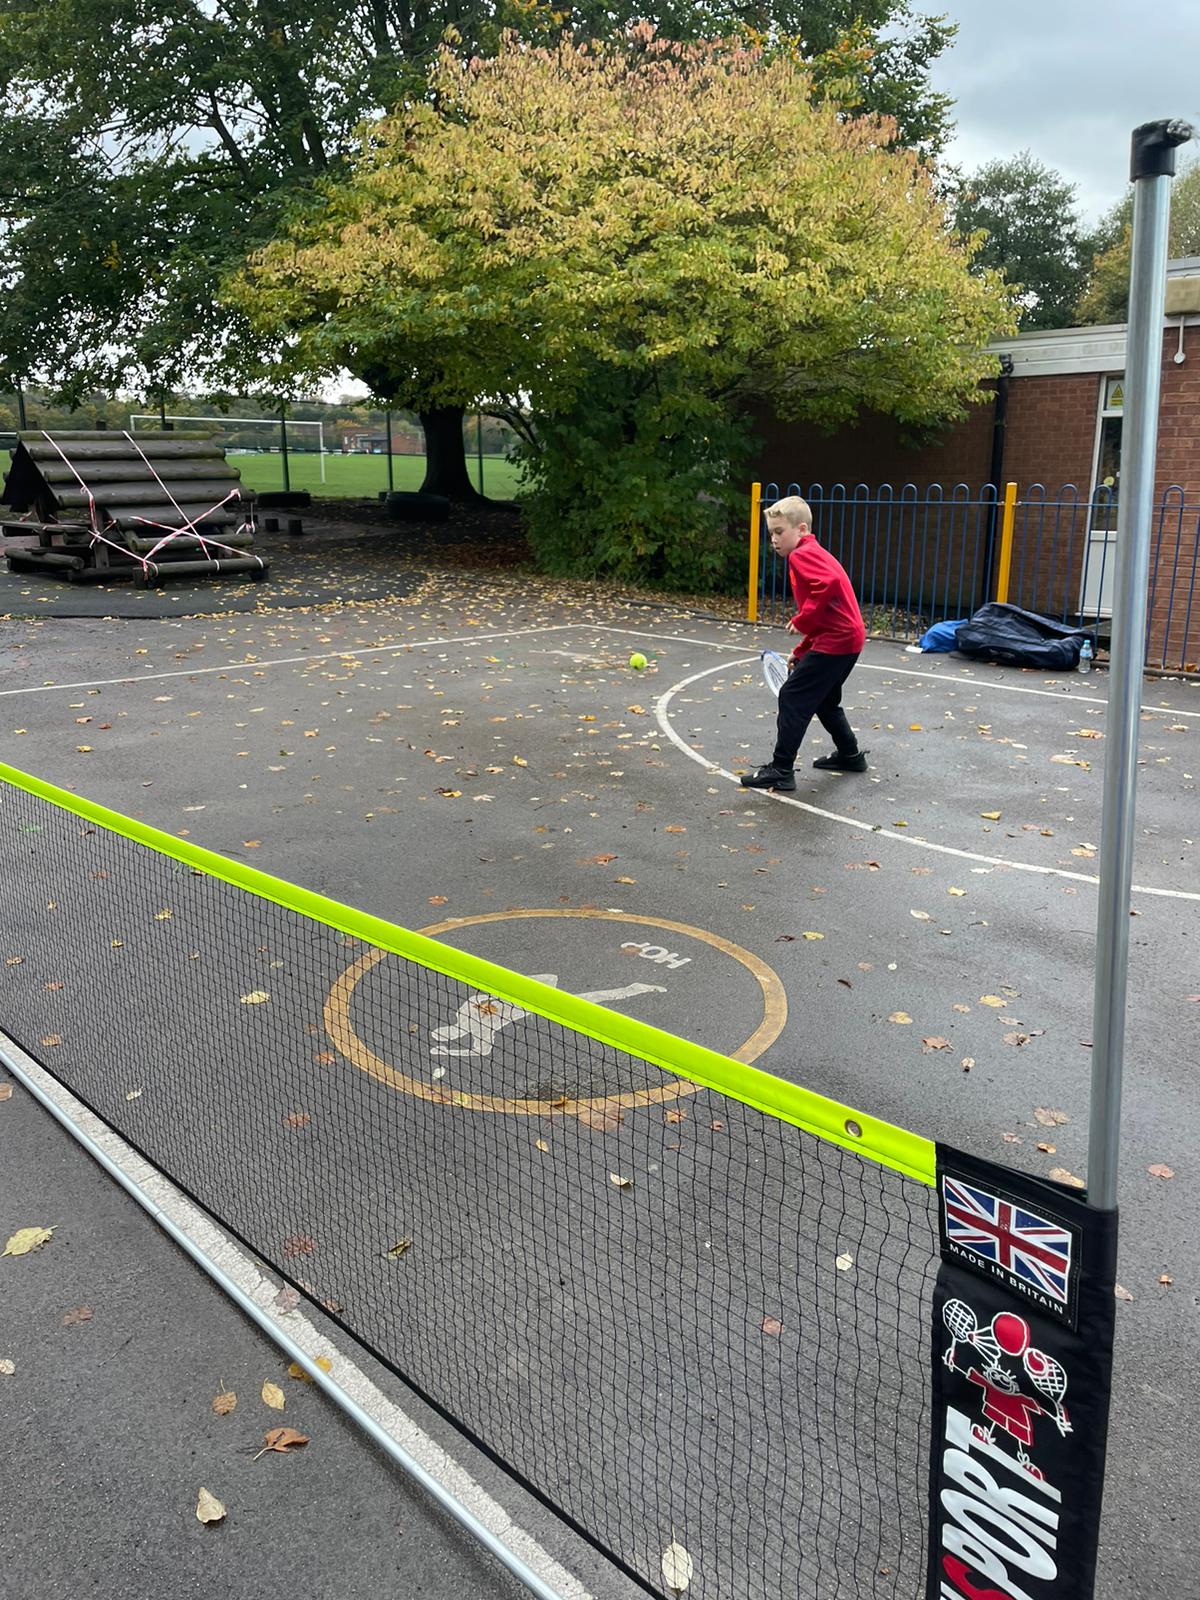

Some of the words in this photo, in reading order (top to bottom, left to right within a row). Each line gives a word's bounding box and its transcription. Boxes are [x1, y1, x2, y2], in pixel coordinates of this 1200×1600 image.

[950, 1243, 985, 1269] MADE
[991, 1265, 1005, 1279] IN
[1009, 1277, 1063, 1314] BRITAIN
[940, 1405, 1062, 1600] SPORT
